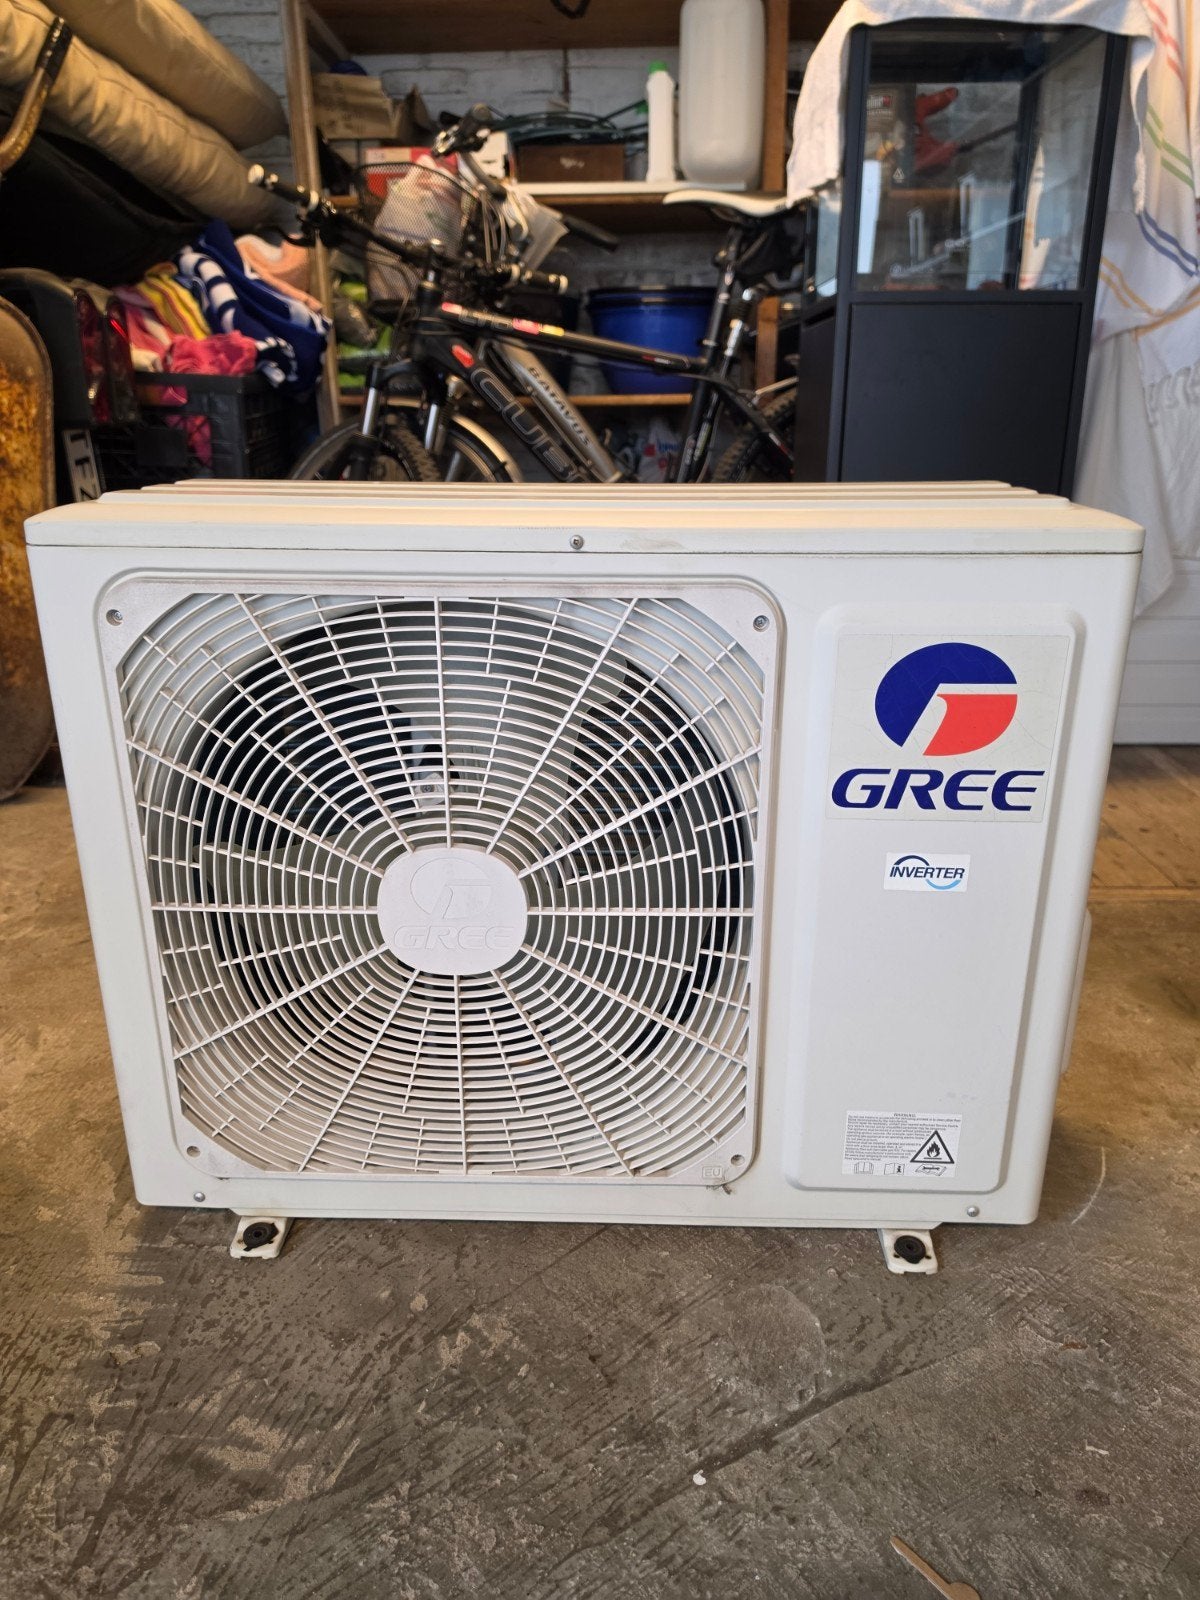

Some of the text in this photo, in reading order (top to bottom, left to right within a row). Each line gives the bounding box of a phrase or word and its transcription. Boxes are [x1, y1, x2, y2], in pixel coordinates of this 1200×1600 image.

[471, 367, 587, 482] CUB
[831, 768, 1045, 811] GREE
[889, 866, 965, 879] INVERTER
[394, 925, 515, 950] GREE
[704, 1167, 721, 1177] EU
